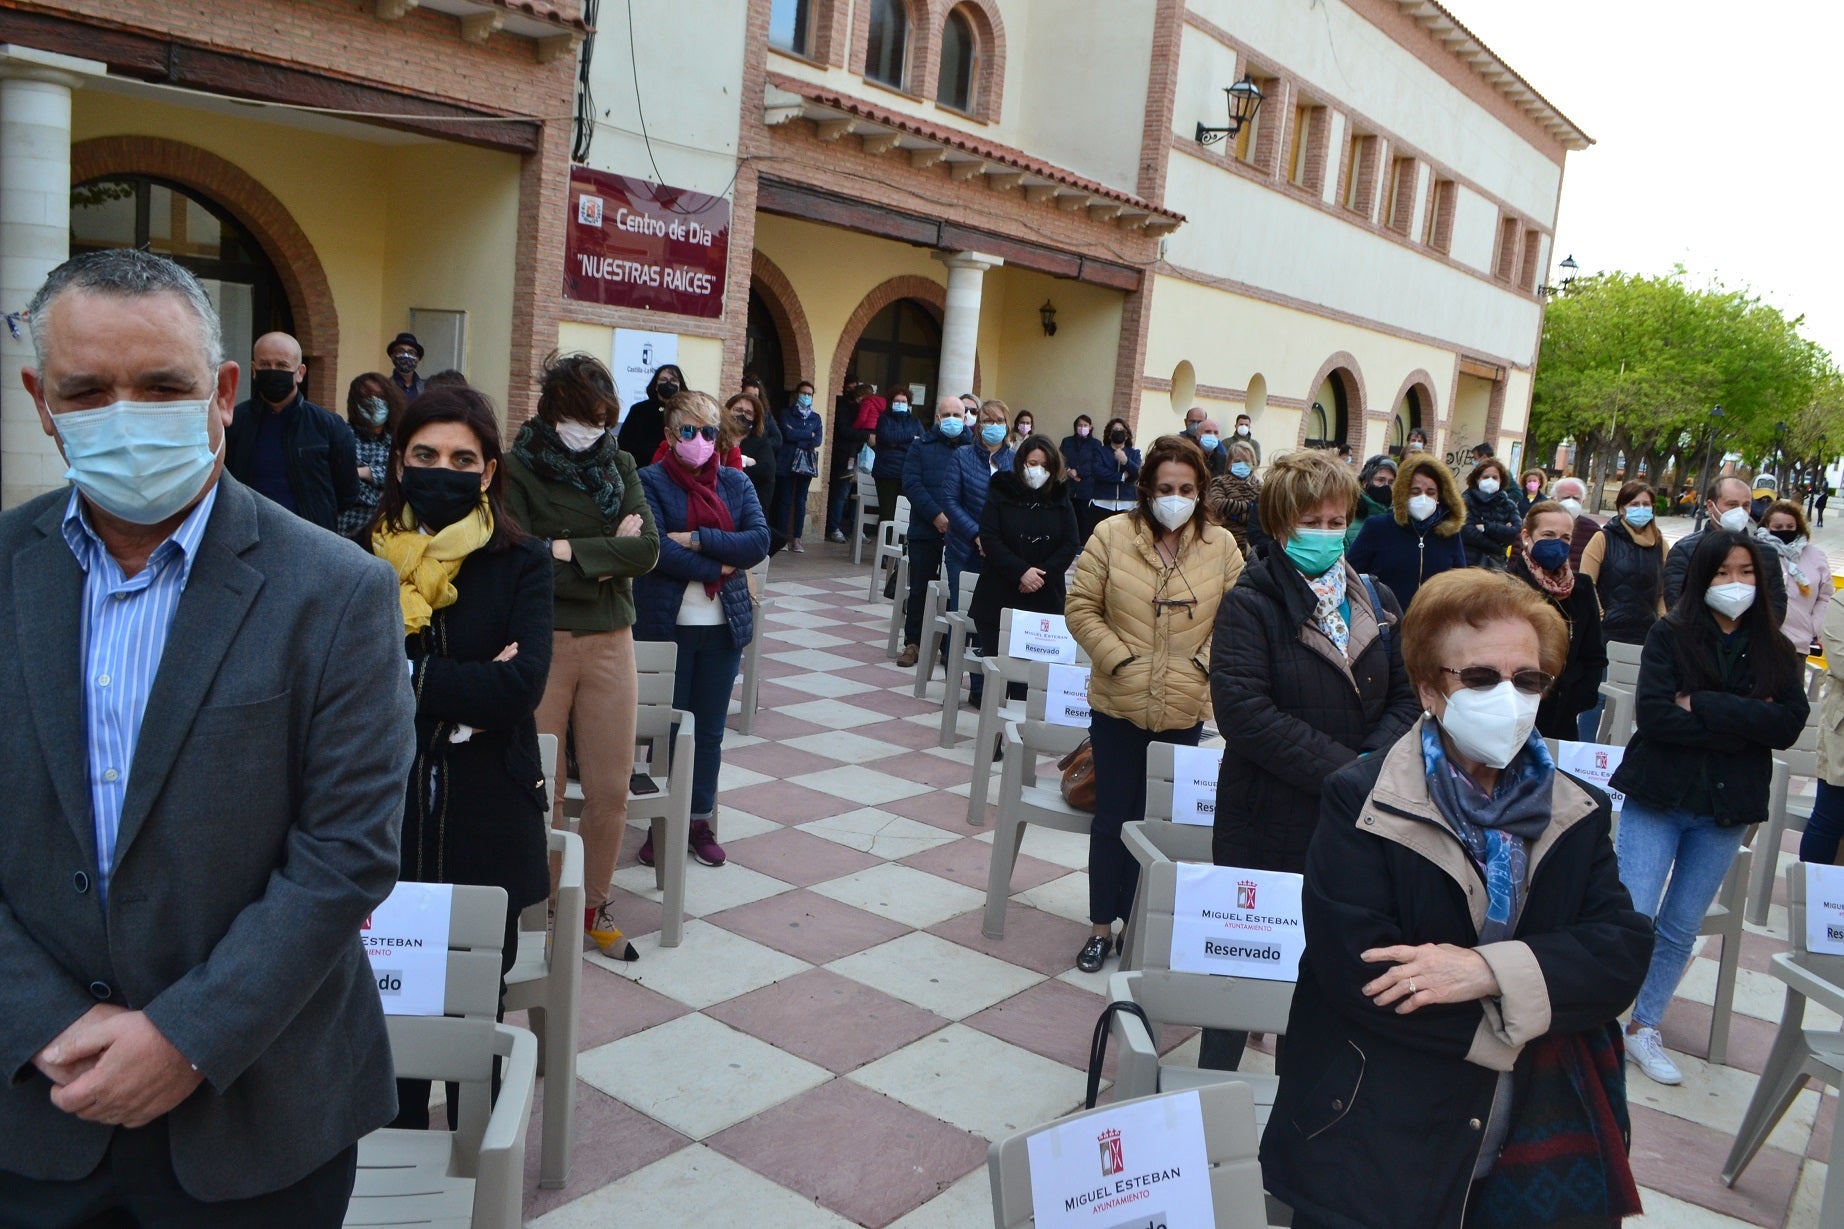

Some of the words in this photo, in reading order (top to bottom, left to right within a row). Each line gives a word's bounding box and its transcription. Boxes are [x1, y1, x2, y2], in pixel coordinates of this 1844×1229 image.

[616, 208, 665, 238] Centro
[669, 219, 686, 242] de
[689, 222, 712, 247] Día
[577, 253, 661, 287] "NUESTRAS
[664, 266, 716, 295] RAÍCES"
[1025, 644, 1060, 655] Reservado
[1574, 767, 1600, 777] MIGUEL
[1202, 909, 1242, 922] MIGUEL
[1245, 914, 1298, 926] ESTEBAN
[1224, 922, 1272, 932] AYUNTAMIENTO
[1205, 941, 1281, 961] Reservado
[1065, 1186, 1113, 1212] MIGUEL
[1115, 1167, 1182, 1194] ESTEBAN
[1092, 1189, 1150, 1215] AYUNTAMIENTO
